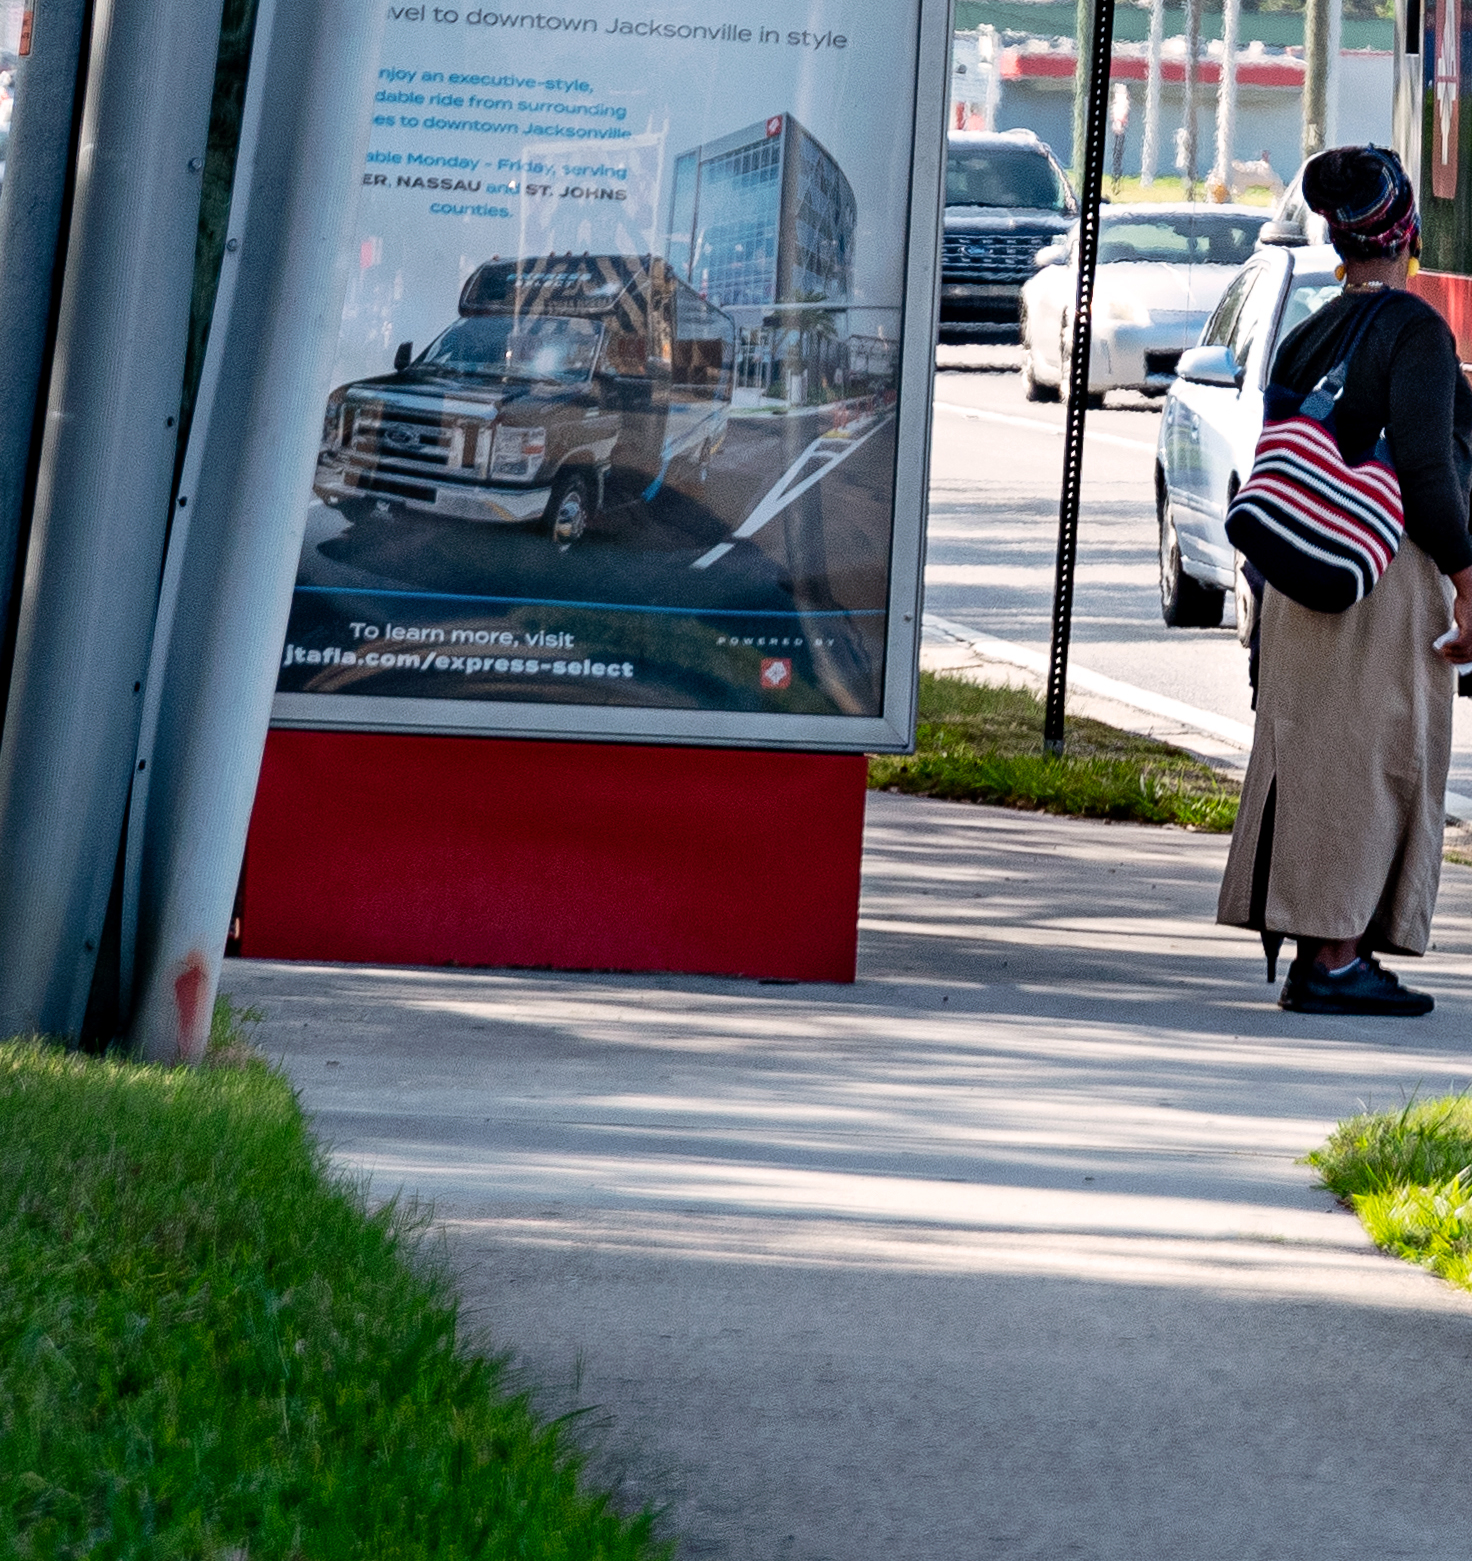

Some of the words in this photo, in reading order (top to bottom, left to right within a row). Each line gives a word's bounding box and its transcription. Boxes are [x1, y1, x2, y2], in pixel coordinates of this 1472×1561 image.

[387, 4, 426, 22] vel
[433, 6, 459, 24] to
[466, 8, 598, 33] downtown
[605, 18, 753, 43] Jacksonville
[758, 25, 781, 44] in
[787, 29, 849, 51] style
[378, 66, 418, 84] njoy
[421, 71, 445, 83] an
[448, 72, 594, 94] executive-style,
[374, 89, 425, 106] dable
[430, 93, 464, 107] ride
[469, 95, 513, 110] from
[517, 100, 628, 121] surrounding
[401, 116, 420, 128] to
[423, 116, 519, 134] downtown
[522, 122, 633, 139] Jacksonville
[366, 150, 403, 165] able
[407, 152, 480, 172] Monday
[562, 164, 628, 181] serving
[396, 175, 482, 192] NASSAU
[485, 181, 521, 196] and
[558, 185, 628, 201] JOHNS
[430, 202, 514, 218] counties.
[350, 622, 380, 640] To
[385, 623, 445, 643] learn
[451, 628, 520, 648] more,
[525, 630, 576, 649] visit
[716, 636, 804, 647] POWERED
[283, 643, 635, 679] jtafla.com/express-select
